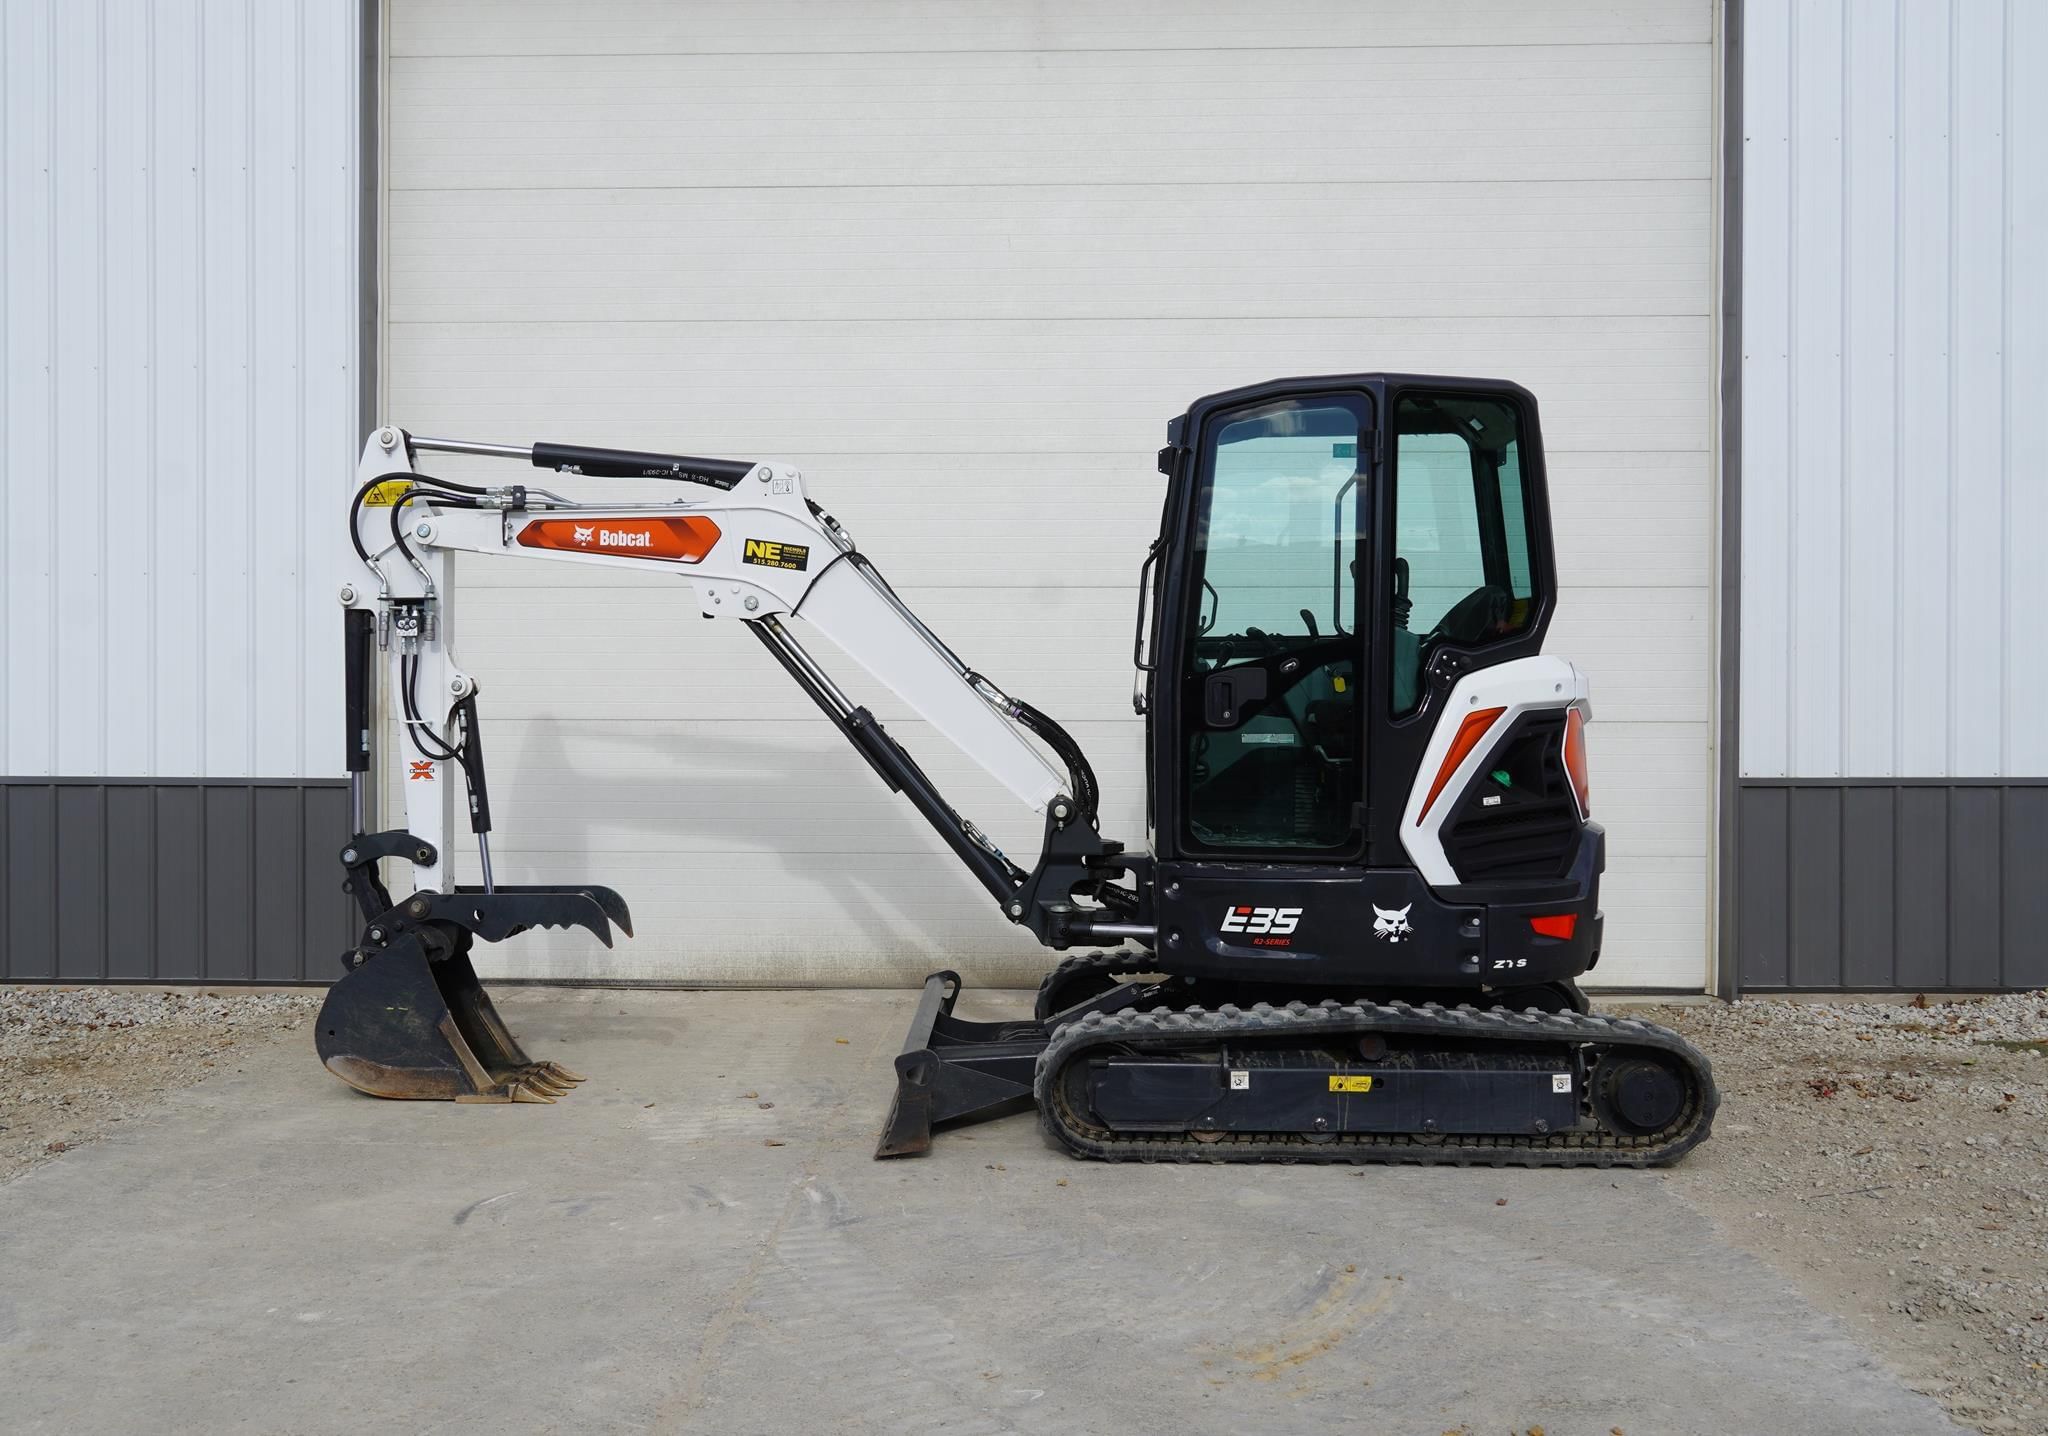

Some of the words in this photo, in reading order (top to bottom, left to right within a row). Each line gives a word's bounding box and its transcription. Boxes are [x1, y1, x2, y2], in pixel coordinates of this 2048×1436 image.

[600, 529, 648, 548] Bobcat
[746, 540, 782, 560] NE
[753, 558, 797, 569] 515.280.7600
[1220, 906, 1303, 934] E35
[1253, 938, 1291, 946] R2-SERIES
